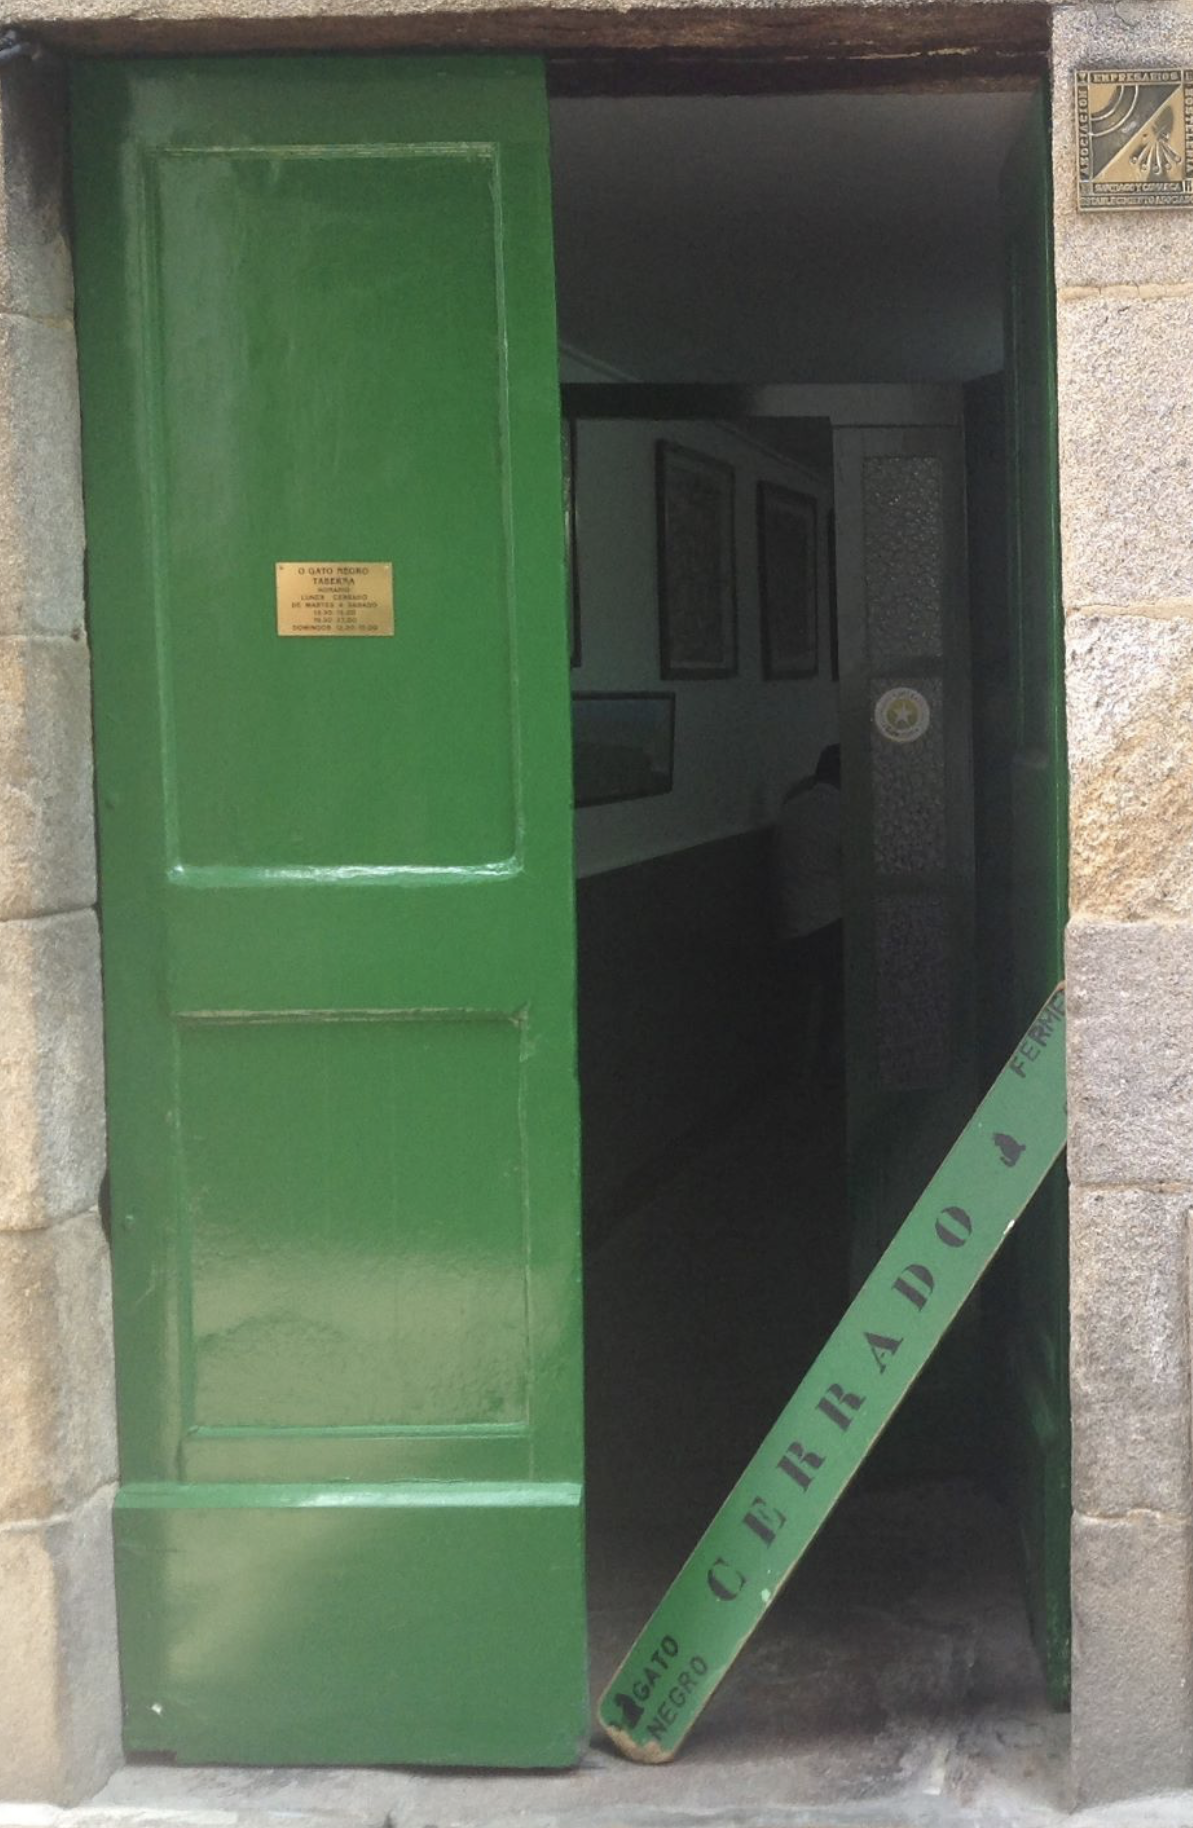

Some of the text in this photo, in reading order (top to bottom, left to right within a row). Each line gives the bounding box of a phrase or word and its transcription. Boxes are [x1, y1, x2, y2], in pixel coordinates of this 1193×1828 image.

[1093, 72, 1179, 82] EMPRESARIOS
[298, 567, 369, 575] O GATO NEGRO
[313, 577, 355, 585] TABERNA
[707, 1206, 972, 1602] CERRADO
[633, 1635, 678, 1701] GATO
[647, 1656, 707, 1741] NEGRO
